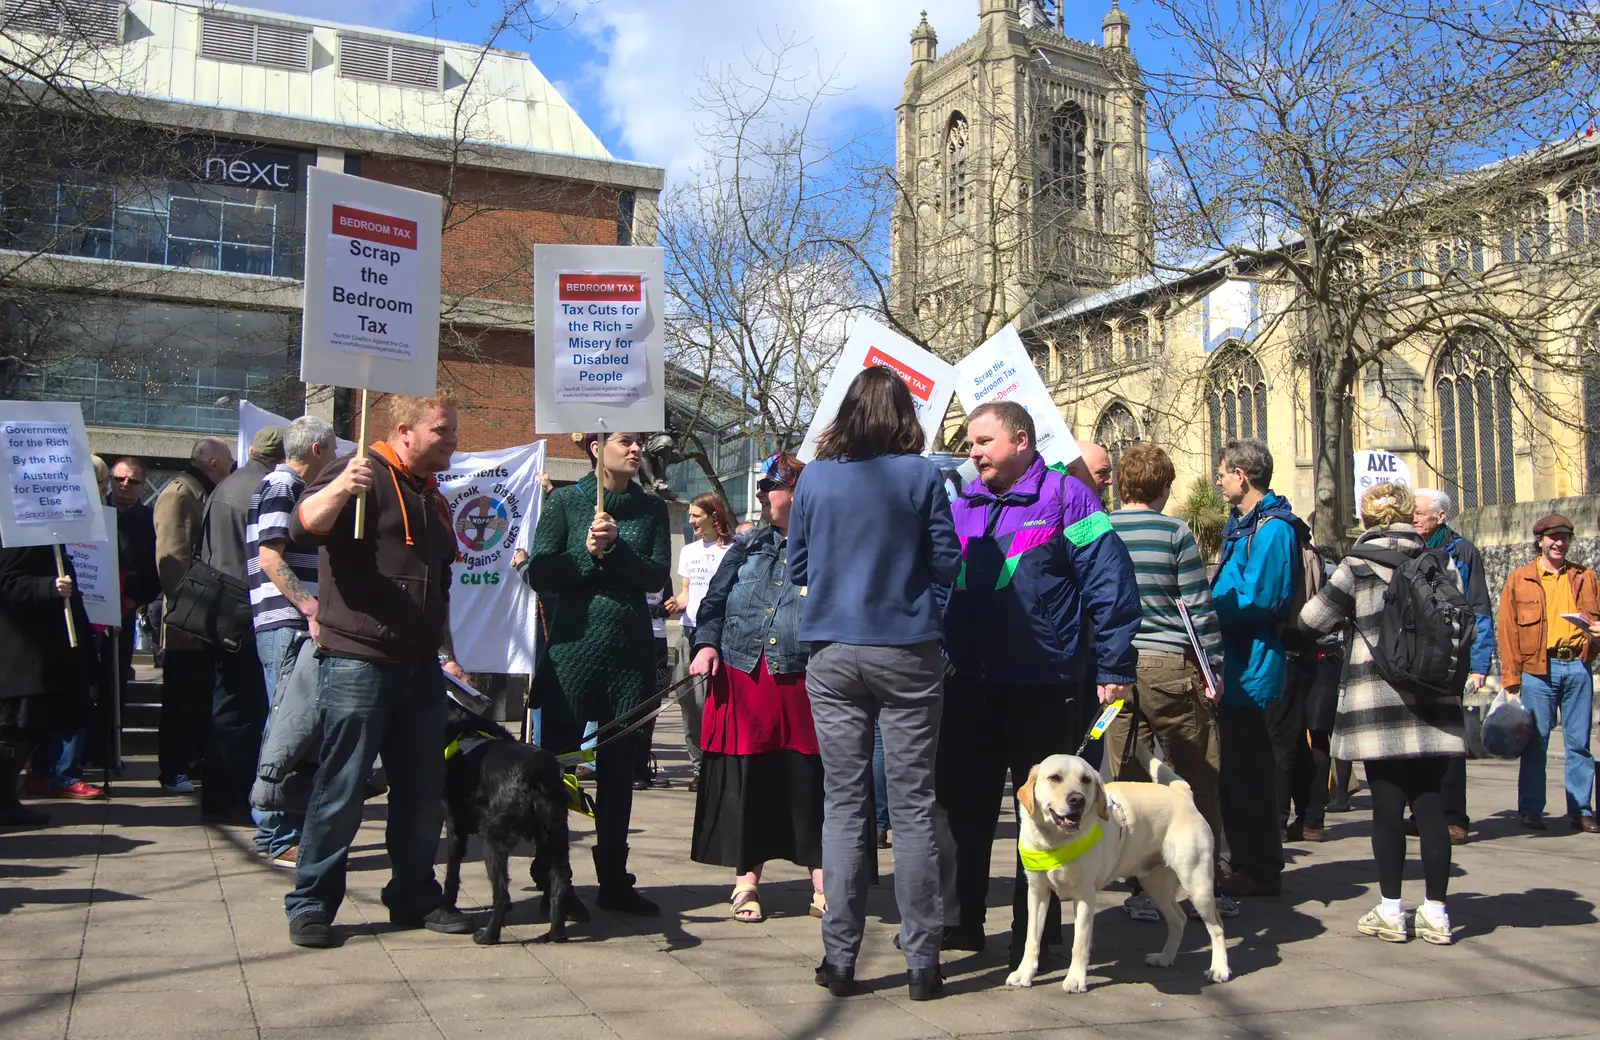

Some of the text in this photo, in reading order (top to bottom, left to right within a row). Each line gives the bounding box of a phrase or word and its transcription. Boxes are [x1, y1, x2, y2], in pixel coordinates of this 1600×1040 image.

[205, 156, 290, 187] next
[340, 215, 411, 239] BEDROOM TAX
[350, 239, 400, 267] Scrap
[360, 266, 388, 286] the
[566, 283, 635, 293] BEDROOM TAX
[332, 286, 413, 315] Bedroom
[561, 303, 640, 315] Tax Cuts for
[357, 315, 388, 335] Tax
[568, 320, 589, 332] the
[593, 320, 622, 332] Rich
[568, 337, 633, 351] Misery for
[573, 354, 629, 365] Disabled
[579, 370, 623, 384] People
[974, 360, 1005, 386] Scrap the
[912, 378, 927, 393] TAX
[974, 367, 1017, 401] Bedroom Tax
[984, 381, 1020, 403] n-Dems:
[5, 425, 68, 435] Government
[8, 438, 69, 448] for the Rich
[12, 454, 72, 466] By the Rich
[1367, 453, 1397, 472] AXE
[23, 470, 69, 481] Austerity
[14, 484, 81, 494] for Everyone
[39, 496, 62, 506] Else
[25, 510, 46, 519] Equal
[73, 550, 90, 560] Stop
[462, 549, 502, 571] Against
[72, 561, 98, 572] tacking
[78, 571, 98, 581] abled
[460, 570, 500, 585] cuts
[79, 582, 95, 590] ople
